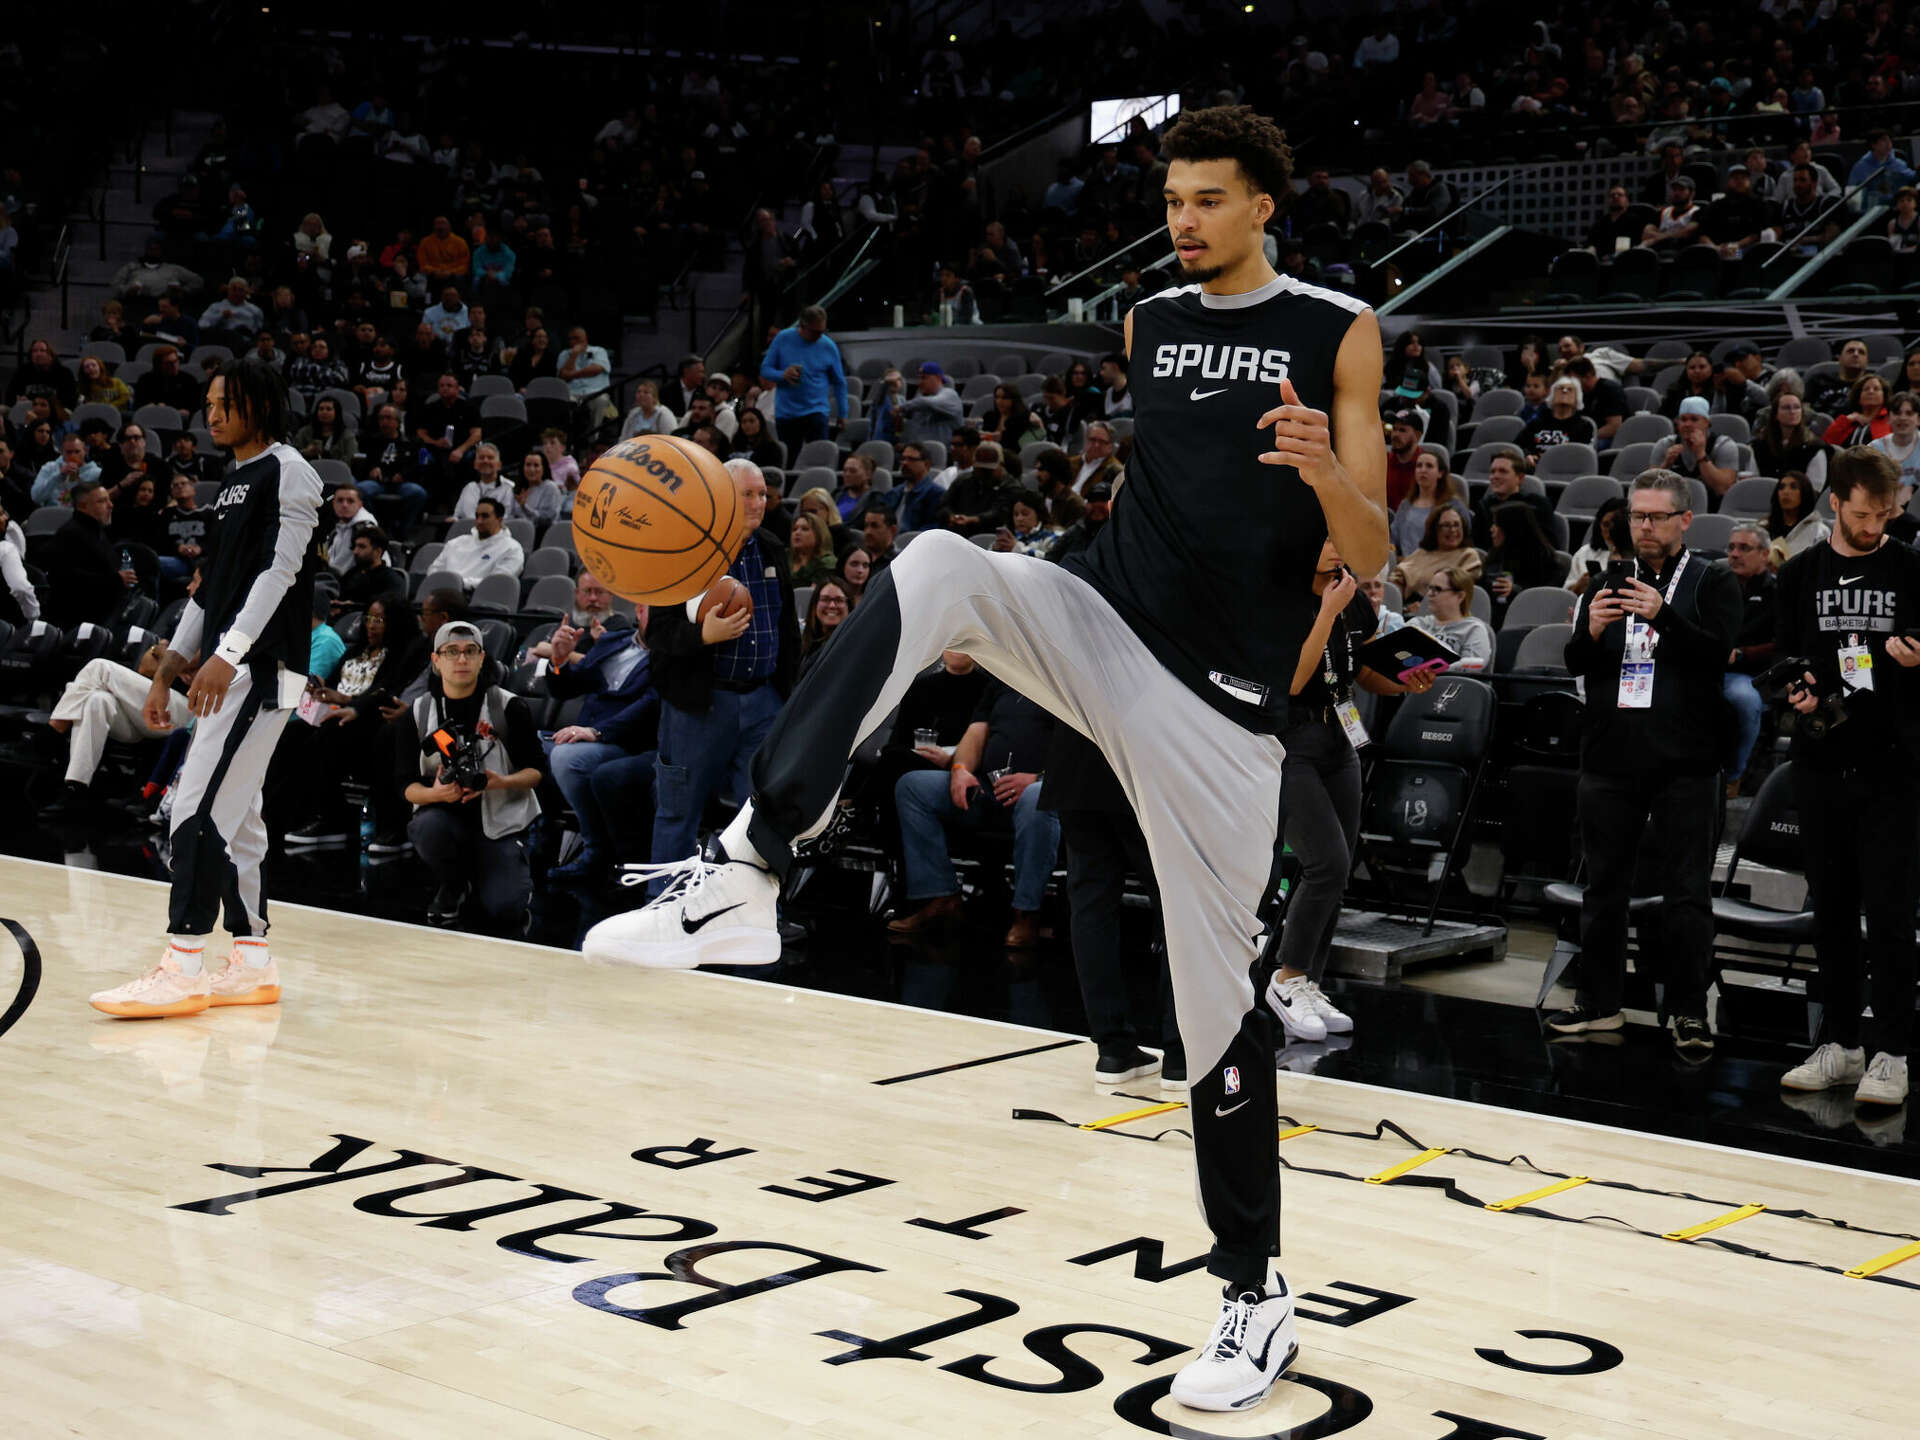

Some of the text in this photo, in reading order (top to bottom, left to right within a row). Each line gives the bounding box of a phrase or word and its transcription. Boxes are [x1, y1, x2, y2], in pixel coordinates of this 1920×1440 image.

[1153, 344, 1291, 384] SPURS
[1824, 619, 1880, 629] BASKETBALL
[168, 1134, 888, 1331] Bank
[631, 1137, 1625, 1376] CENTER
